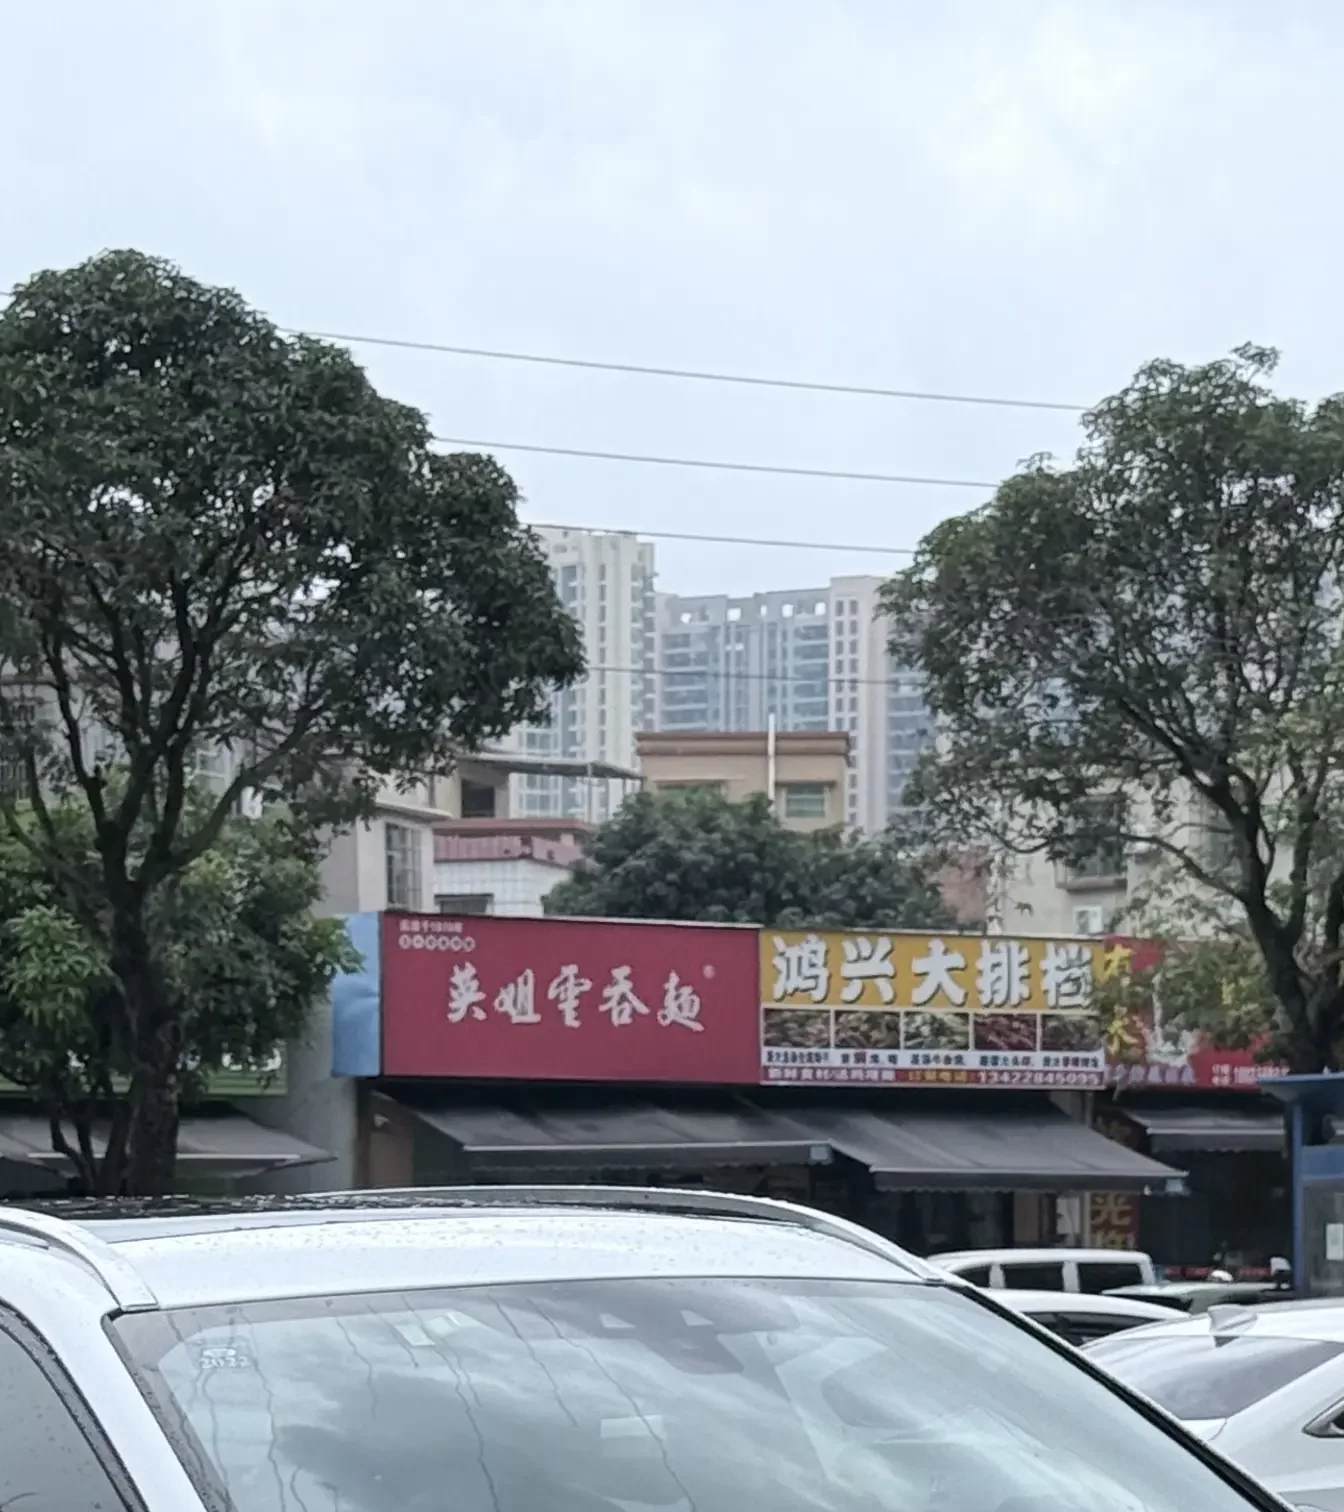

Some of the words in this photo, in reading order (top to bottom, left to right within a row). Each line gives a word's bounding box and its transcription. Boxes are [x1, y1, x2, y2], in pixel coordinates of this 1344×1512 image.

[771, 934, 1094, 1008] 鸿兴大排档
